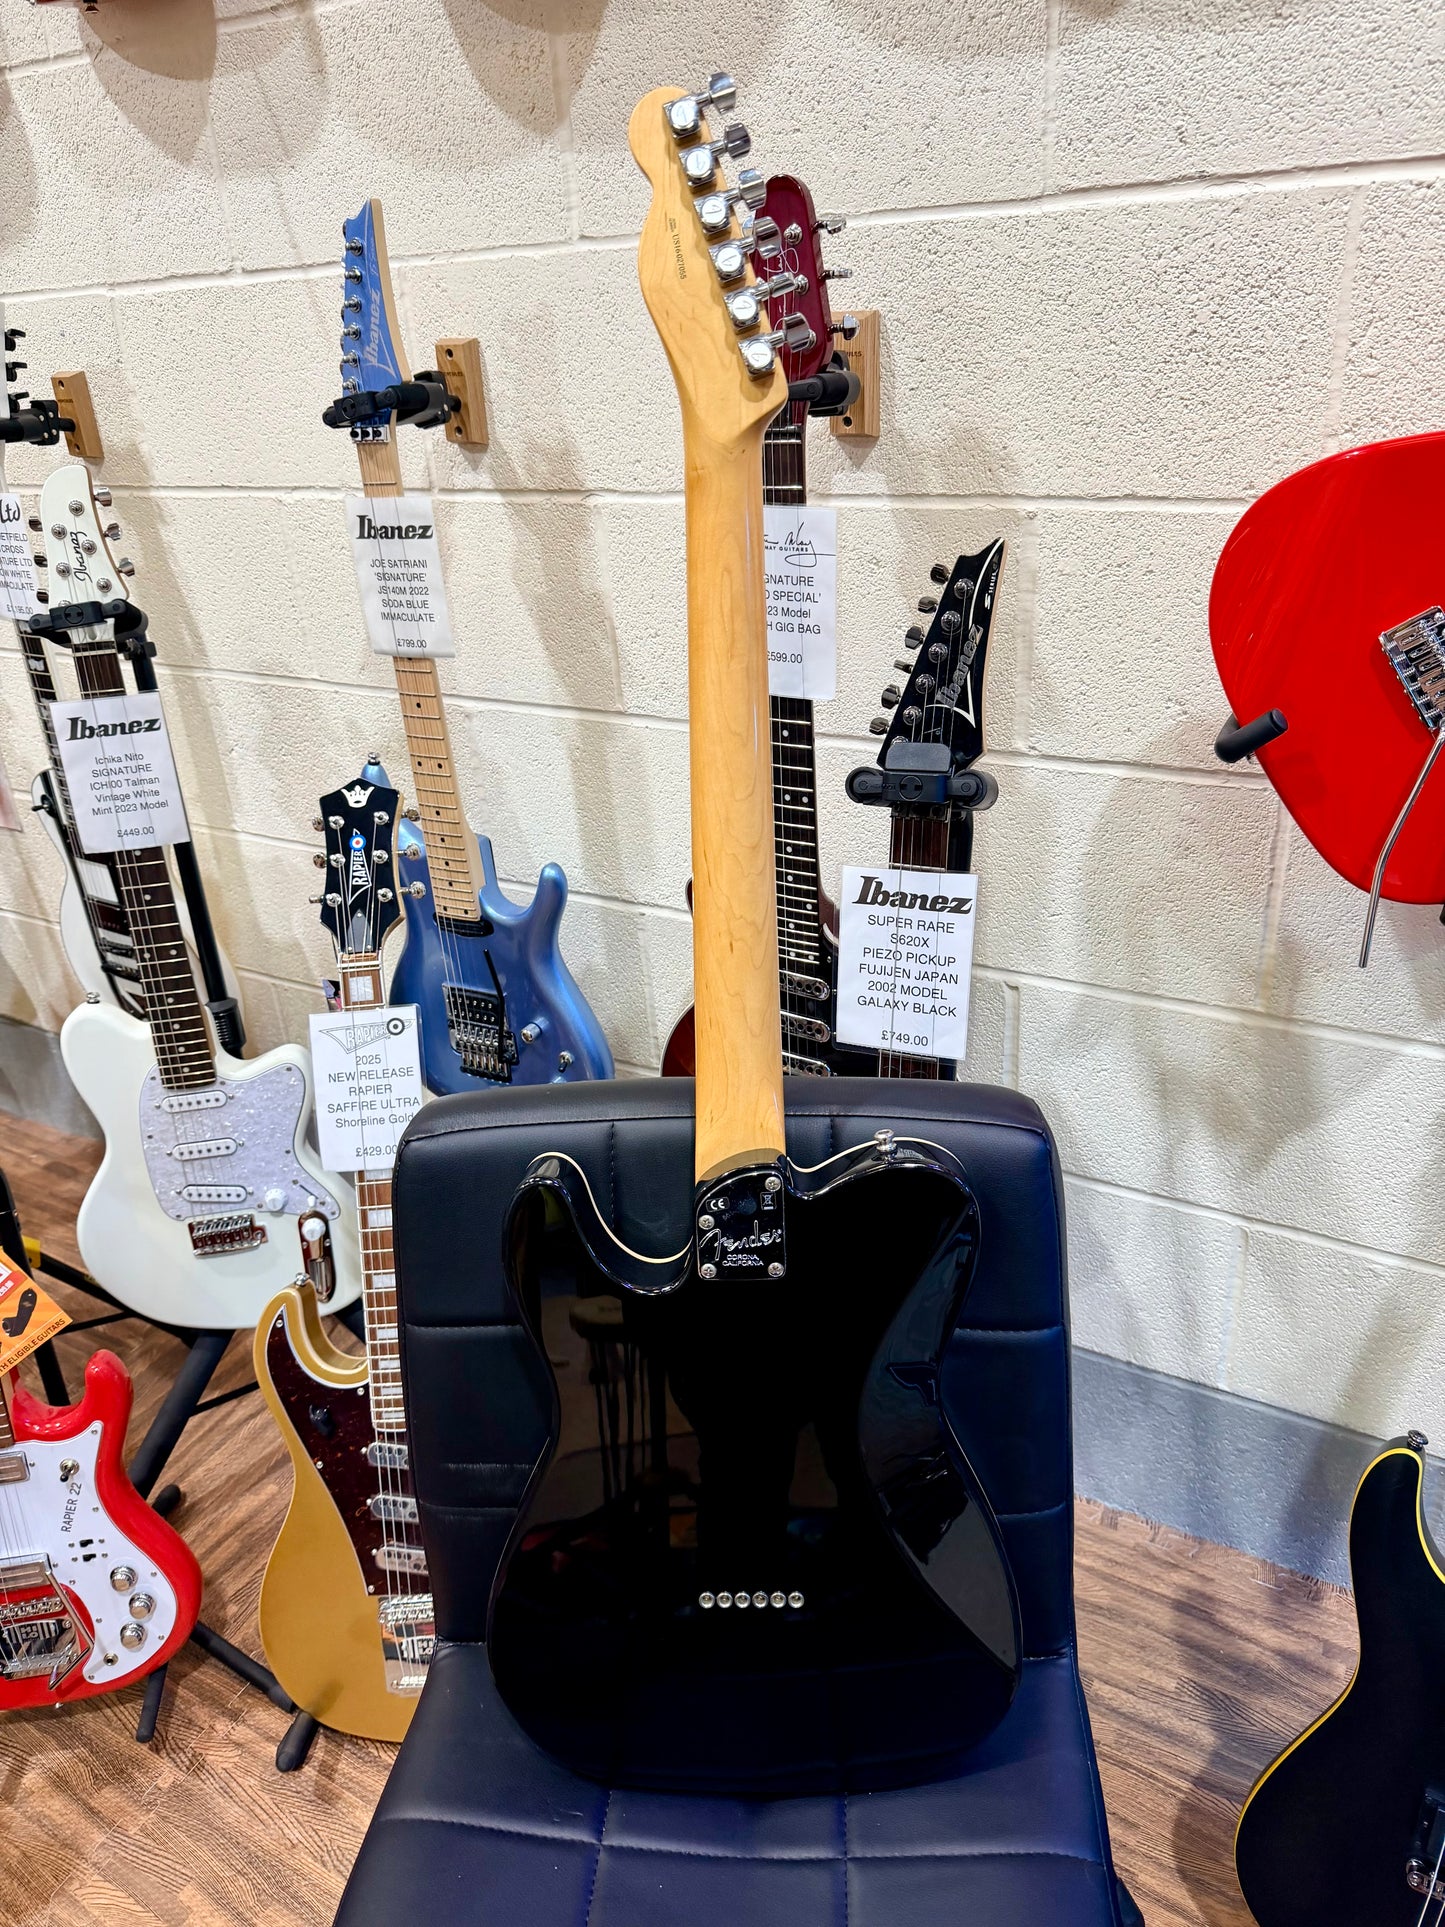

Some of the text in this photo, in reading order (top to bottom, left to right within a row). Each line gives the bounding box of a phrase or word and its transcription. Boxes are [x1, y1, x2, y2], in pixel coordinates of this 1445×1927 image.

[363, 288, 381, 366] Ibanez
[356, 514, 434, 540] Ibanez
[0, 532, 28, 542] ETFIELD
[370, 559, 428, 569] JOE SATRIANI
[374, 572, 427, 582] 'SIGNATURE'
[377, 586, 429, 596] JS140M 2022
[773, 590, 822, 604] SPECIAL'
[382, 599, 430, 609] SODA BLUE
[381, 612, 436, 622] IMMACULATE
[767, 606, 811, 618] 23 Model
[776, 622, 795, 633] GIG
[798, 623, 821, 635] BAG
[397, 638, 427, 649] £799.00
[936, 624, 984, 708] Ibanez
[65, 716, 161, 741] Ibanez
[95, 753, 144, 765] Ichika Nito
[91, 763, 153, 778] SIGNATURE
[124, 776, 160, 788] Talman
[95, 789, 160, 803] Vintage White
[92, 800, 169, 816] Mint 2023 Model
[117, 826, 155, 838] £449.00
[352, 851, 369, 885] RAPIER
[852, 875, 973, 915] Ibanez
[868, 914, 955, 934] SUPER RARE
[890, 933, 930, 948] S620X
[863, 947, 956, 967] PIEZO PICKUP
[914, 970, 959, 985] JAPAN
[868, 981, 948, 1000] 2002 MODEL
[857, 995, 957, 1017] GALAXY BLACK
[345, 1023, 388, 1049] RAPIER
[881, 1030, 929, 1047] £749.00
[356, 1054, 382, 1066] 2025
[328, 1066, 414, 1083] NEW RELEASE
[349, 1084, 393, 1096] RAPIER
[327, 1097, 421, 1114] SAFFIRE ULTRA
[335, 1112, 414, 1129] Shoreline Gold
[355, 1145, 398, 1158] £429.00
[699, 1219, 782, 1261] Fender
[7, 1339, 39, 1365] ELIGIBLE
[36, 1318, 66, 1342] GUITARS
[61, 1482, 82, 1533] RAPIER 22
